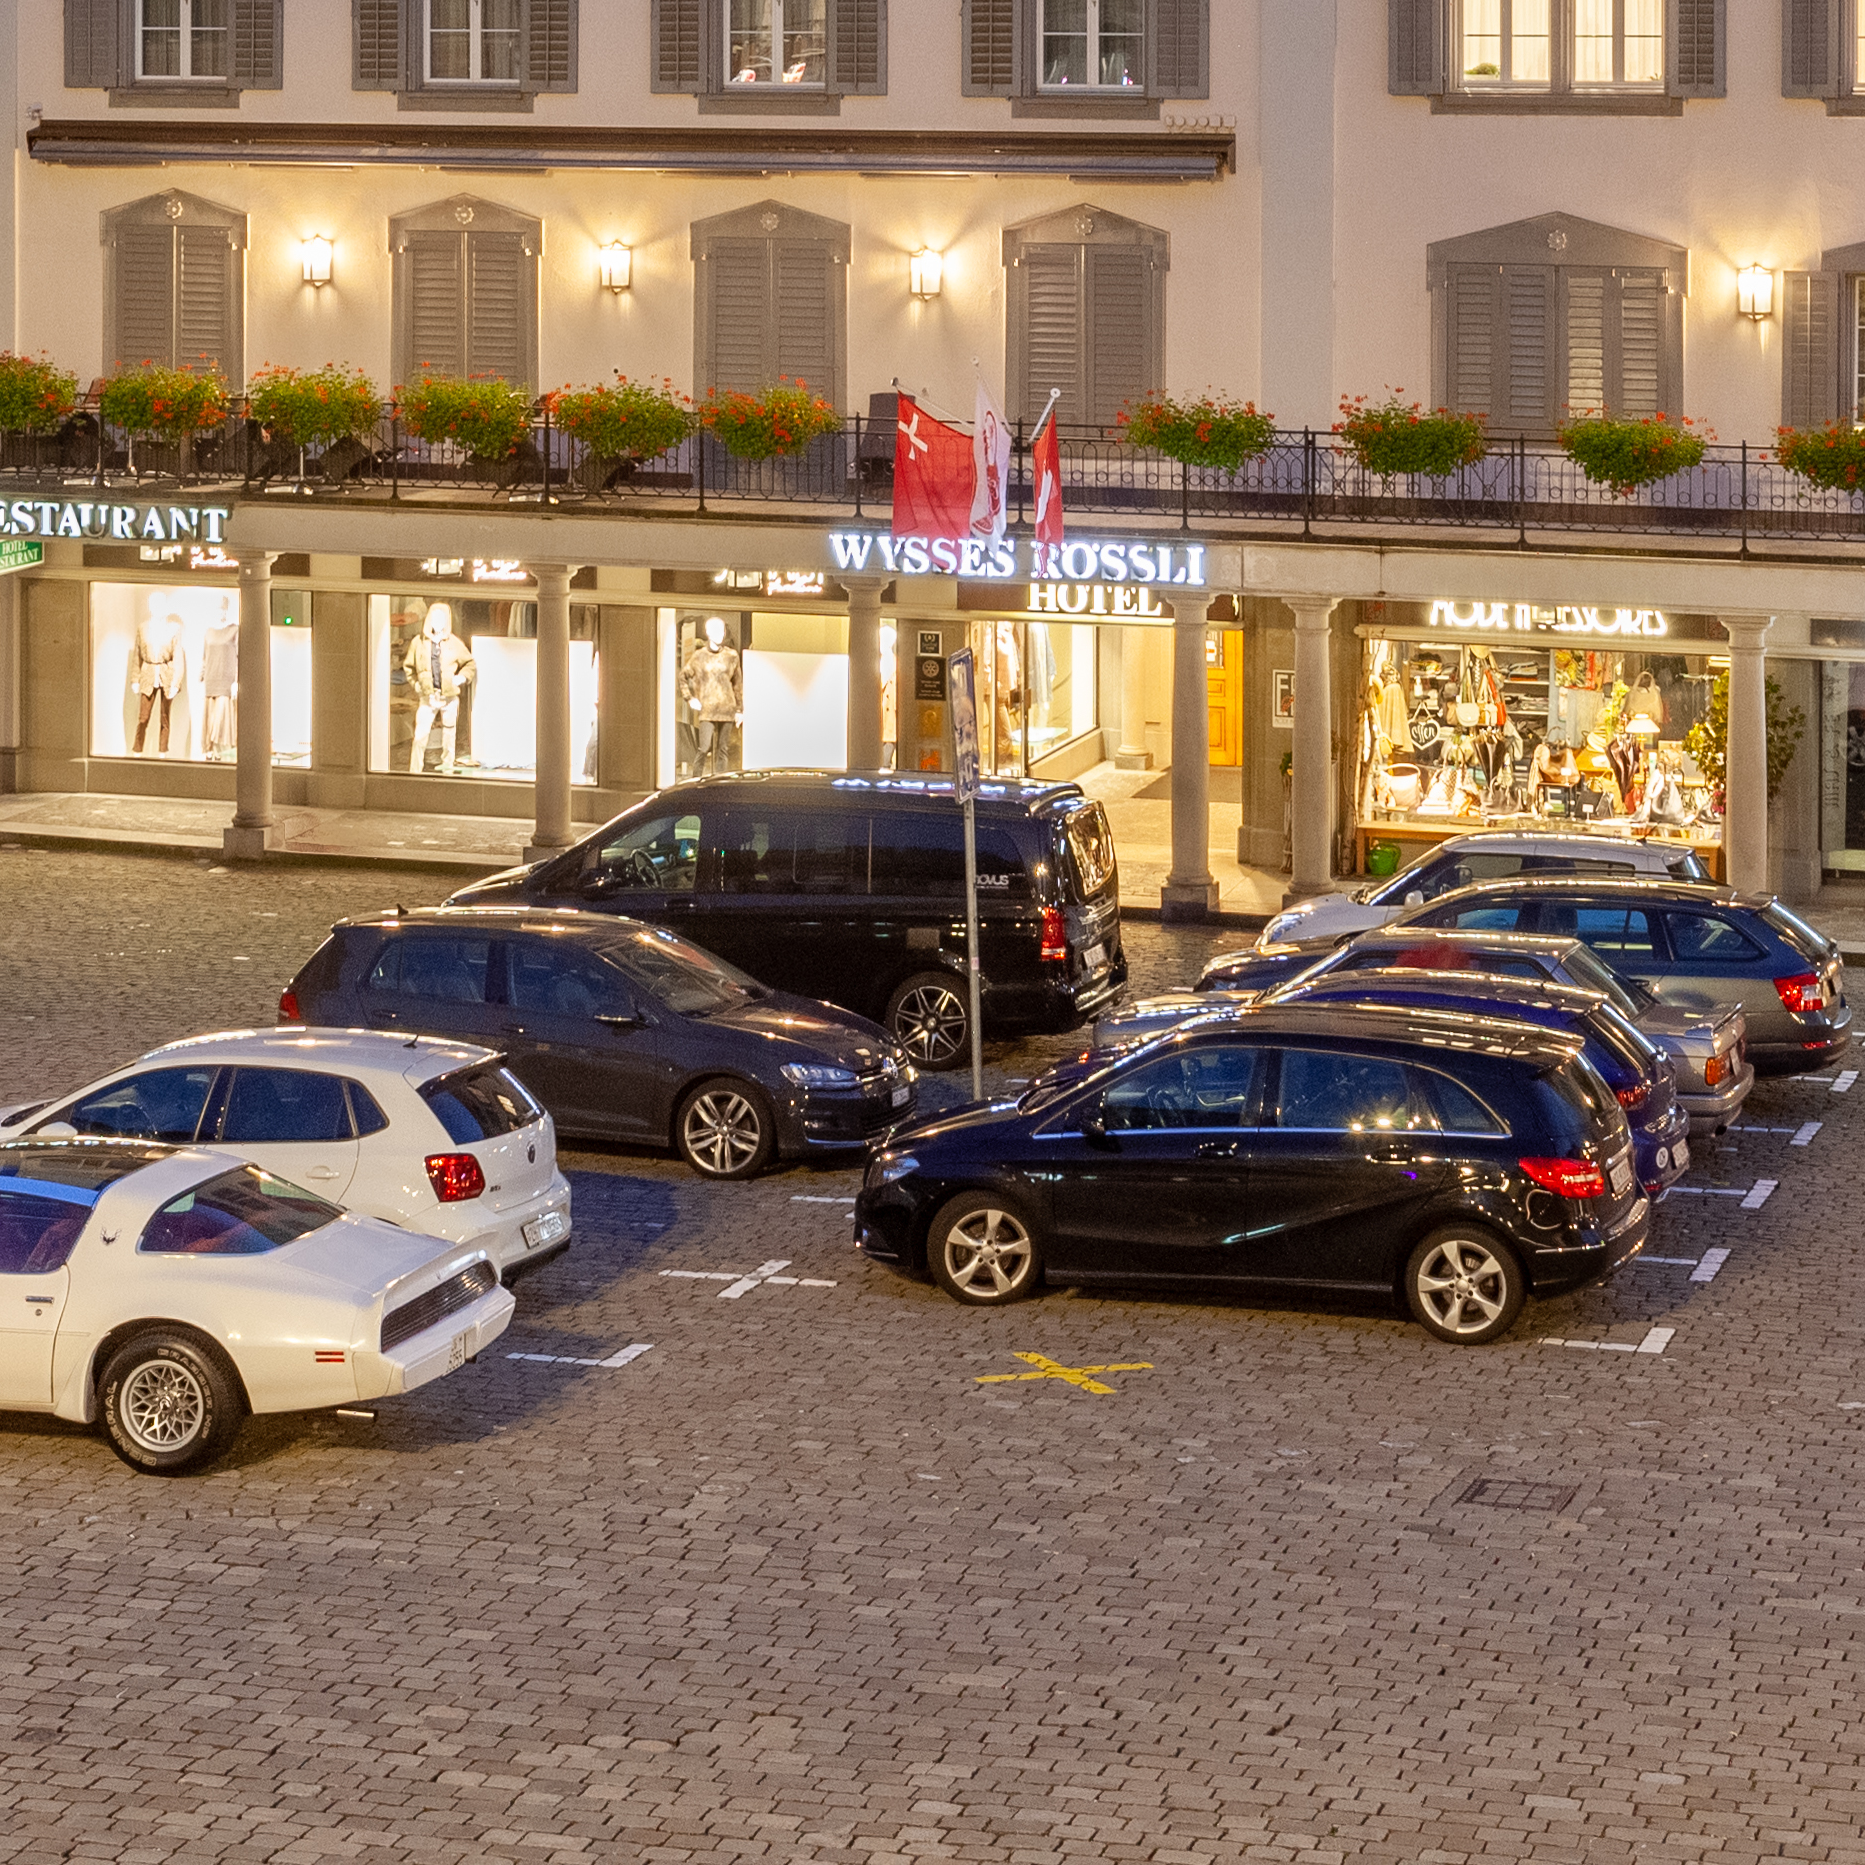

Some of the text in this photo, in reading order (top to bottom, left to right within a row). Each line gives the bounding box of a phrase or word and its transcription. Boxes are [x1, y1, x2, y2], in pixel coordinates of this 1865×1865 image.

[2, 539, 28, 555] HOTEL
[828, 533, 1016, 578] WYSSES
[1026, 582, 1162, 617] HOTEL
[104, 1380, 157, 1467] GENERAL
